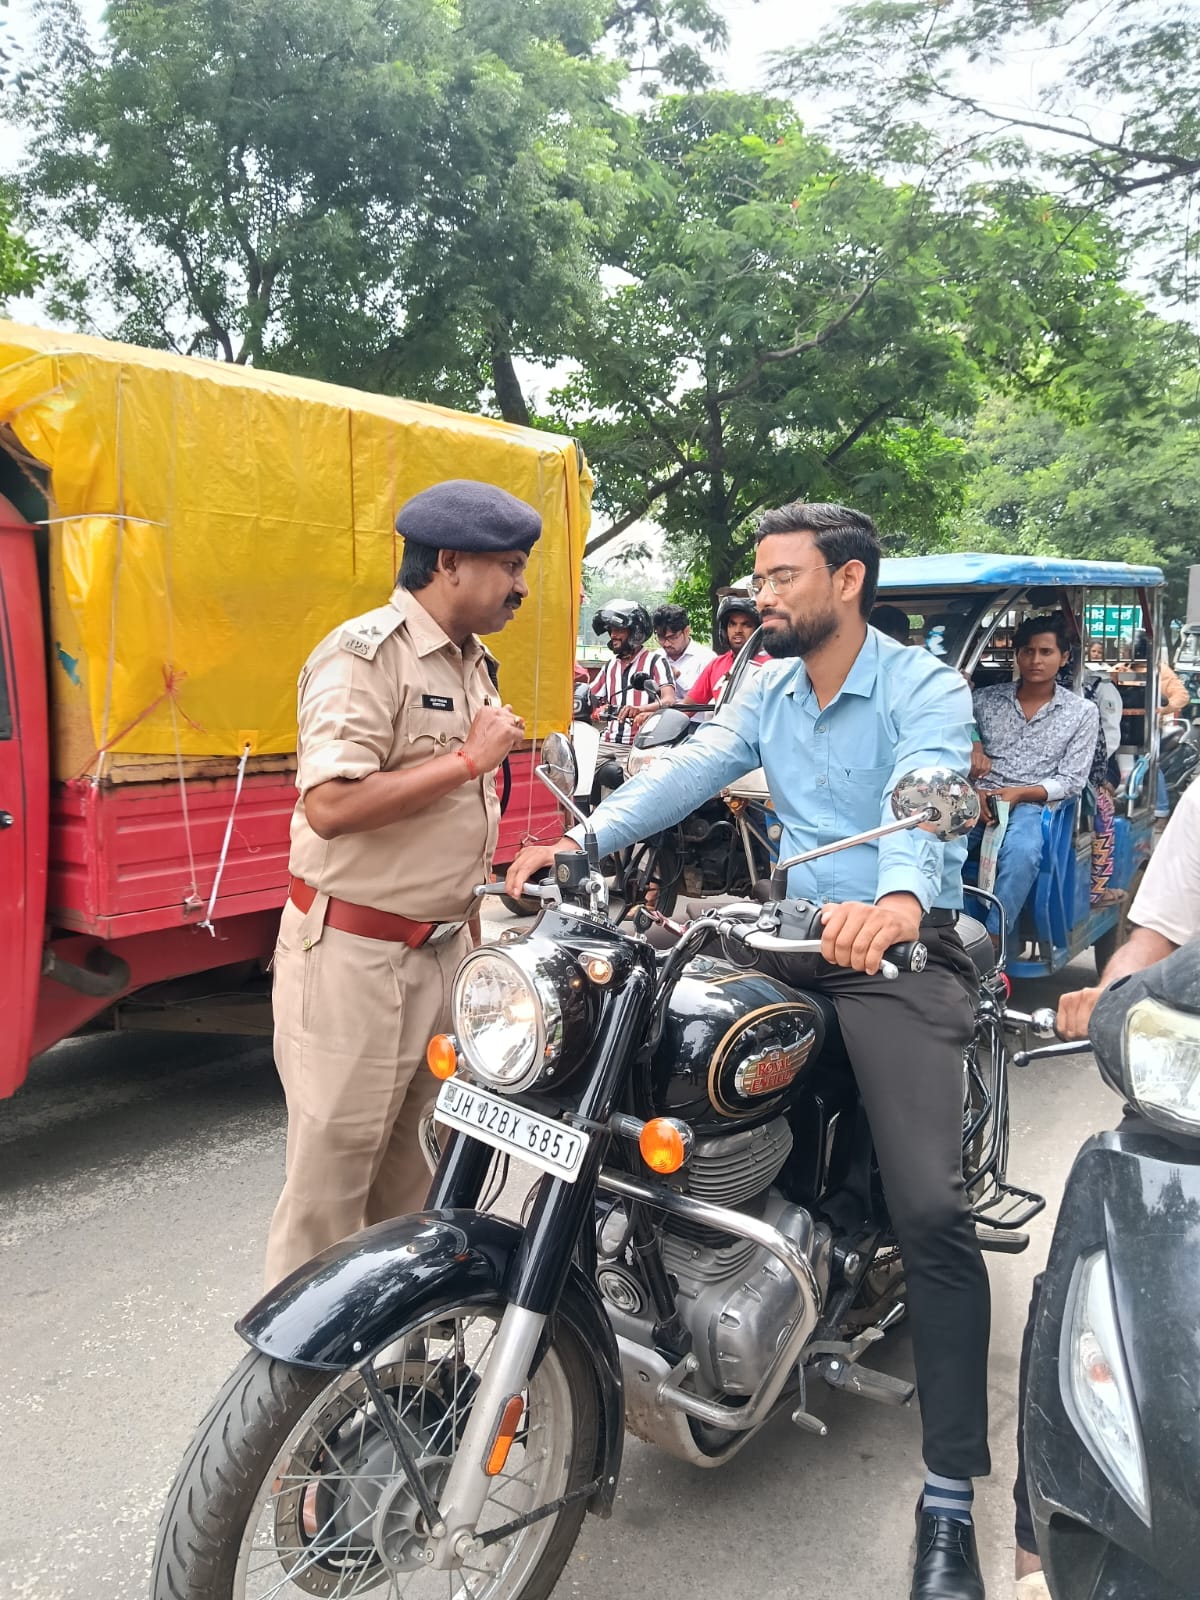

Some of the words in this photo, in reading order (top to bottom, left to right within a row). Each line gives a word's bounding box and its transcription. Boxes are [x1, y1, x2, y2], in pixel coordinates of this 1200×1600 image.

[756, 1056, 791, 1077] ROYAL
[451, 1092, 475, 1118] JH
[477, 1101, 521, 1140] 02BX
[528, 1124, 576, 1164] 6851
